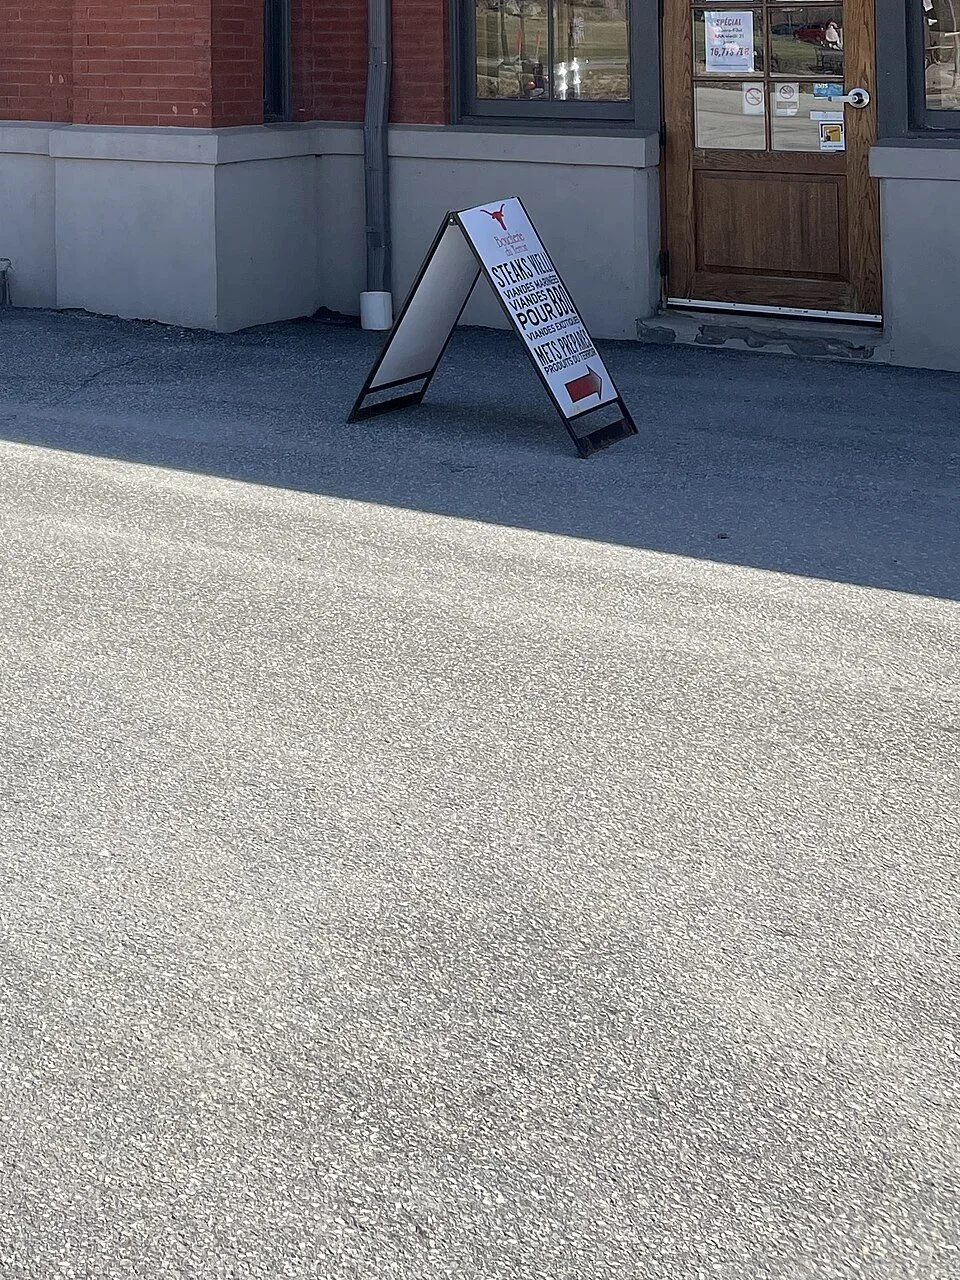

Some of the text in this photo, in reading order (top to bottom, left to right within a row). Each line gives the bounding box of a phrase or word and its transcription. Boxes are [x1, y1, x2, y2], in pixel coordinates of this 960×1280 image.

[715, 17, 742, 27] SPÉCIAL
[491, 258, 534, 288] STEAKS
[503, 281, 536, 300] VIANDES
[509, 289, 548, 311] VIANDES
[516, 284, 576, 330] POUR BBQ
[526, 325, 557, 342] VIANDES
[533, 326, 592, 366] METS PRÉPARÉS
[544, 356, 574, 376] PRODUITS
[571, 353, 581, 365] DU
